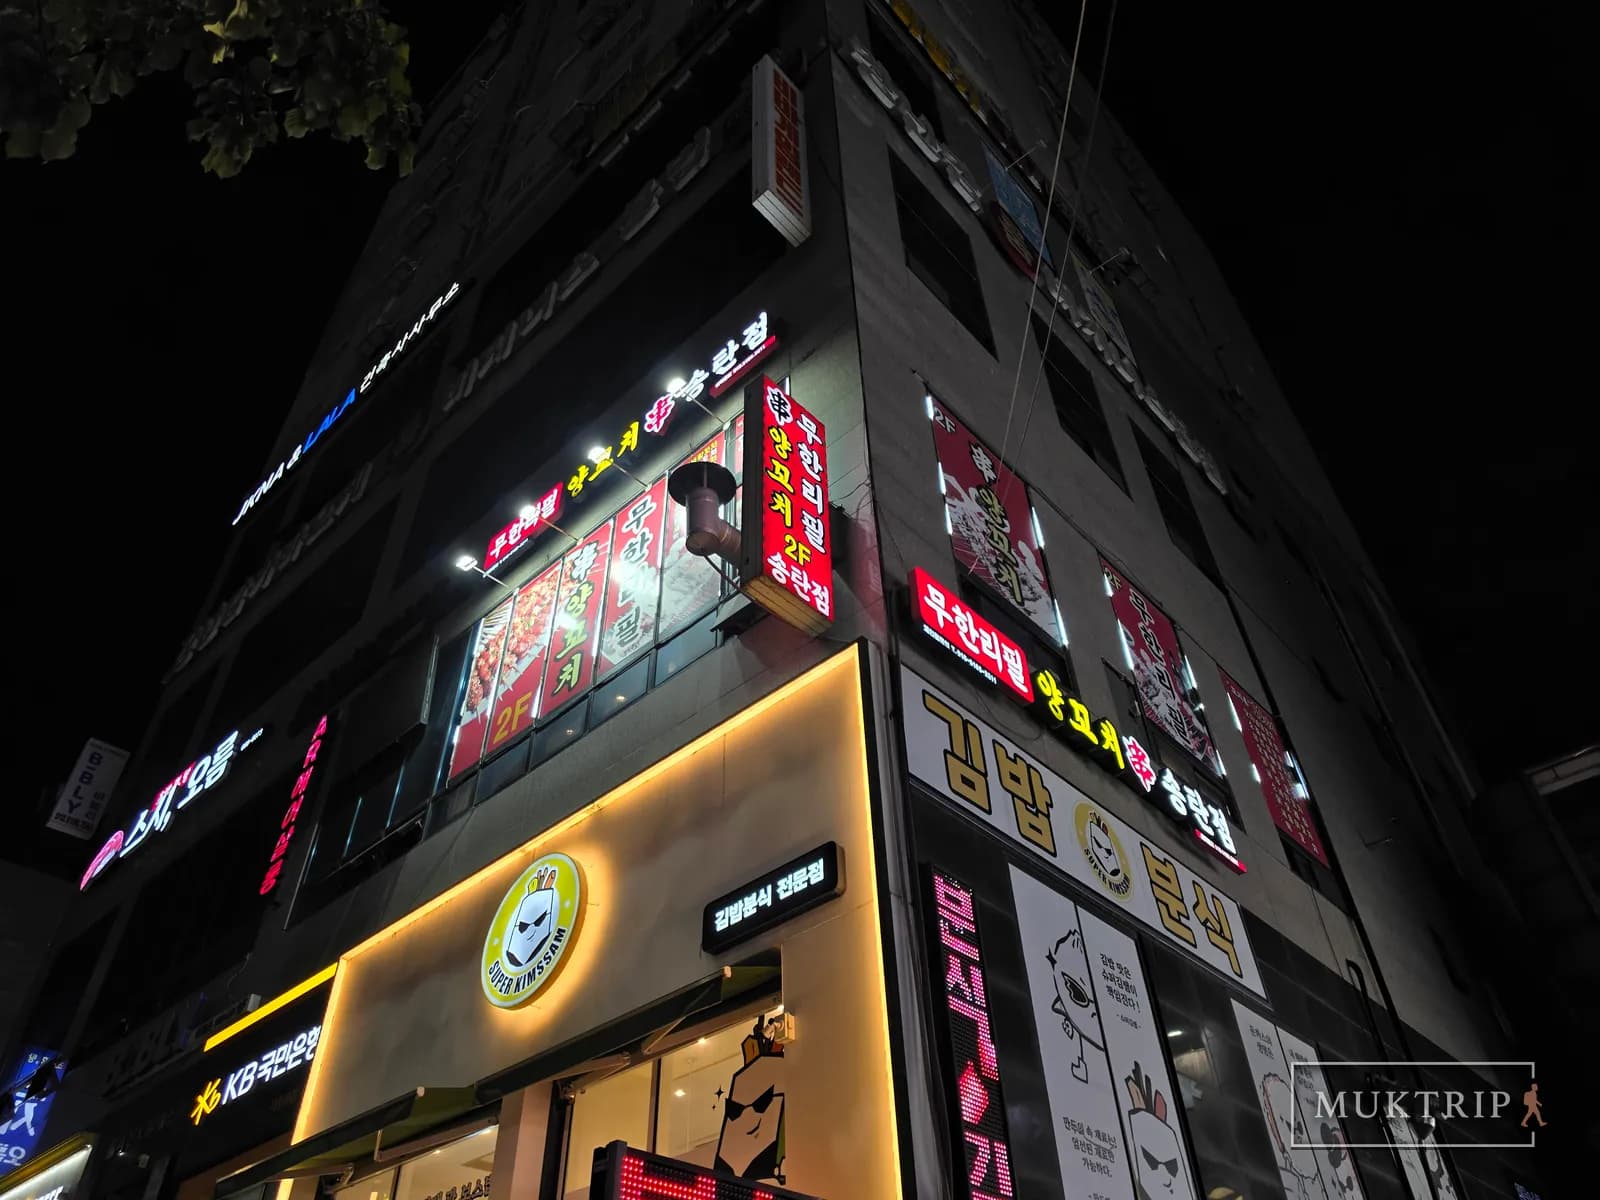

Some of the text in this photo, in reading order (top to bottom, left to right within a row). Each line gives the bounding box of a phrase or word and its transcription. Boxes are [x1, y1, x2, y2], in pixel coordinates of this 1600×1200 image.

[674, 311, 769, 402] 송탄점
[301, 386, 358, 454] LALA
[934, 406, 956, 433] 2F
[767, 425, 794, 528] 양꼬치
[796, 412, 828, 555] 무한리필
[767, 551, 830, 617] 송탄점
[784, 534, 813, 567] 2F
[923, 581, 1030, 694] 무한리필
[493, 691, 532, 742] 2F
[922, 689, 1056, 857] 김밥
[1035, 669, 1126, 771] 양꼬치
[1160, 767, 1237, 856] 송탄점
[714, 857, 825, 932] 김밥분식 전문점
[1084, 848, 1107, 884] SUPER
[1140, 841, 1243, 978] 분식
[488, 926, 567, 996] SUPER KIMSSAM
[1099, 953, 1131, 979] 김밥 맛은
